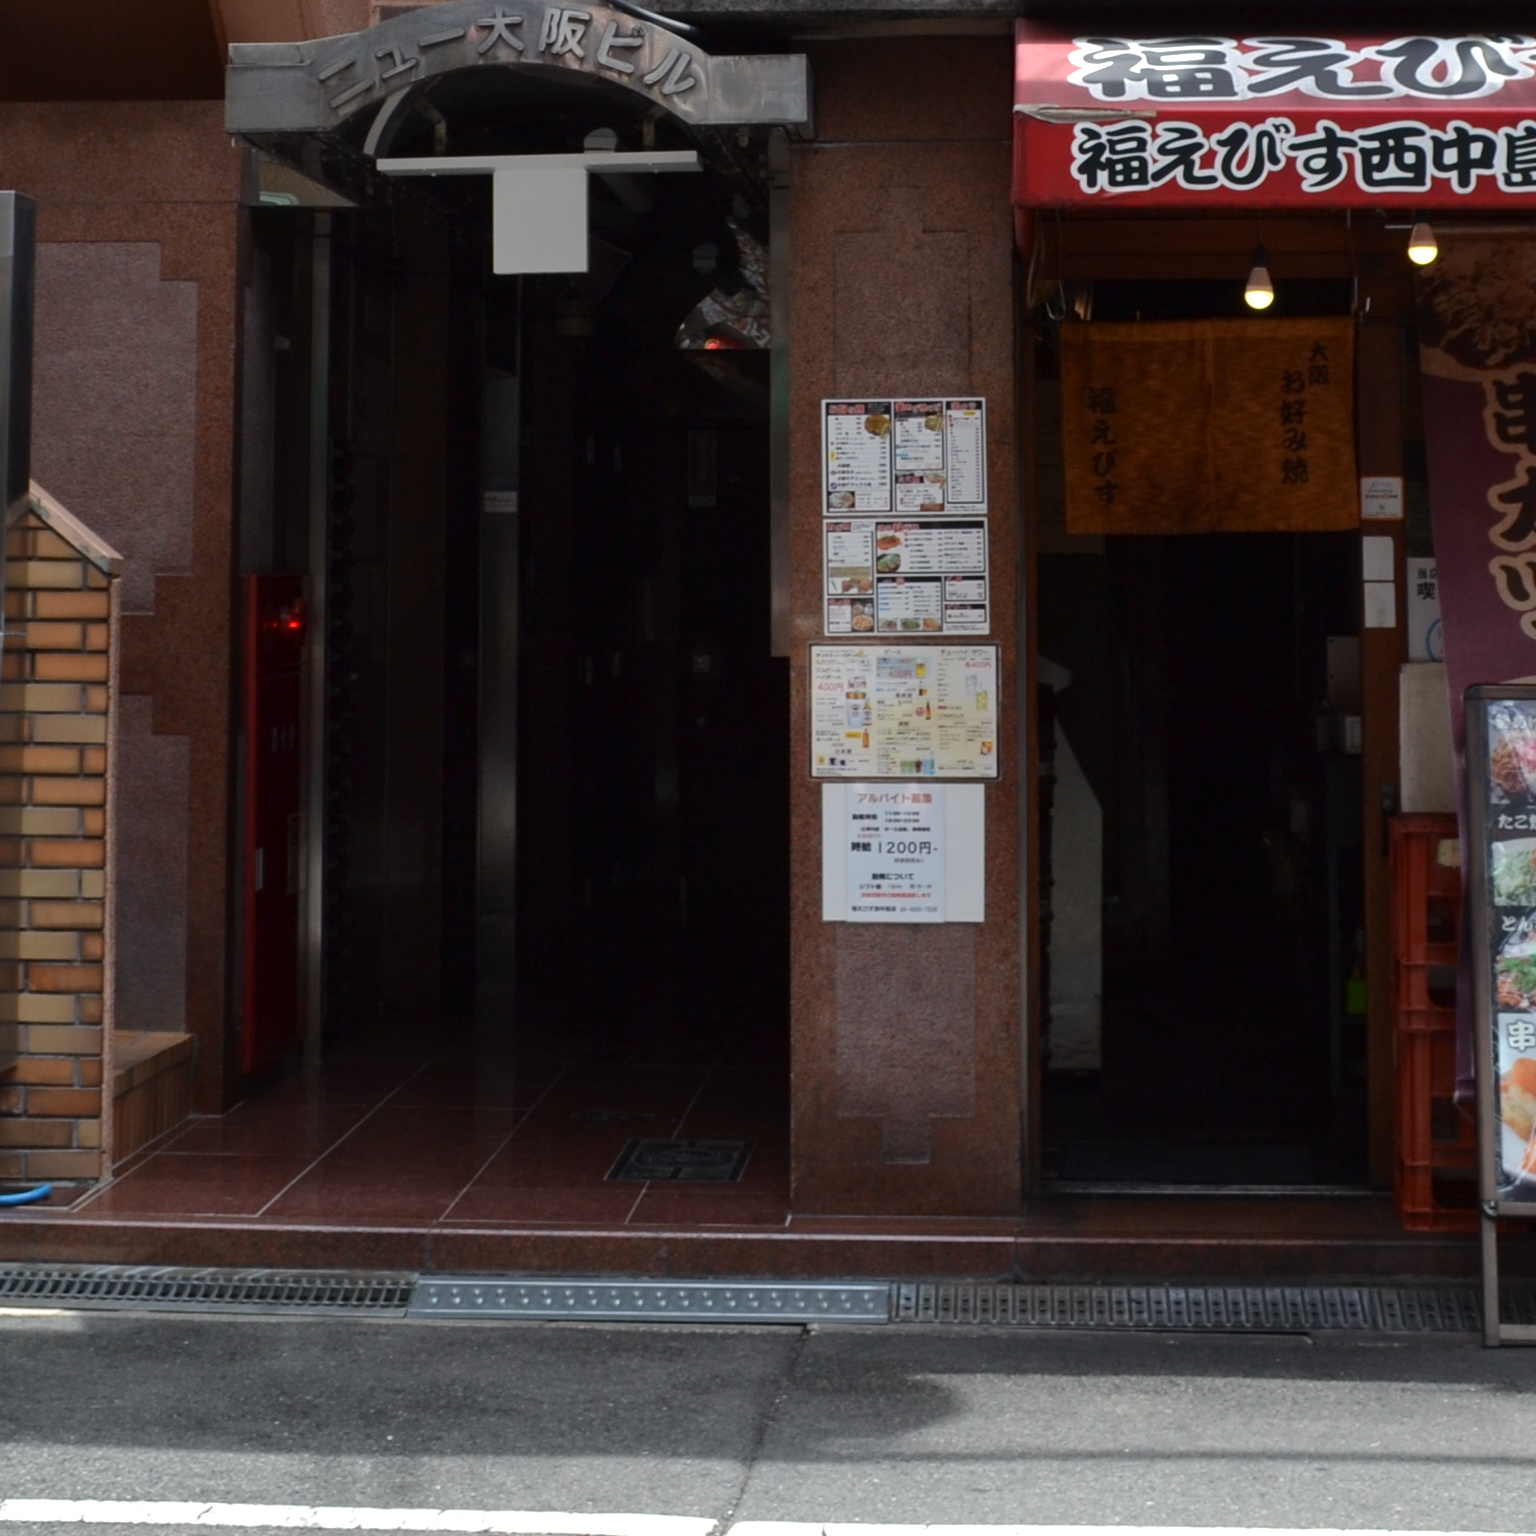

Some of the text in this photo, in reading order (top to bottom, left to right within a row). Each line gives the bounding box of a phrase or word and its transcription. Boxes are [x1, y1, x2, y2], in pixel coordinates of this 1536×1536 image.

[318, 6, 698, 112] ニュー大阪ビル
[1088, 387, 1120, 508] 福えびす
[1279, 369, 1309, 486] お好み焼
